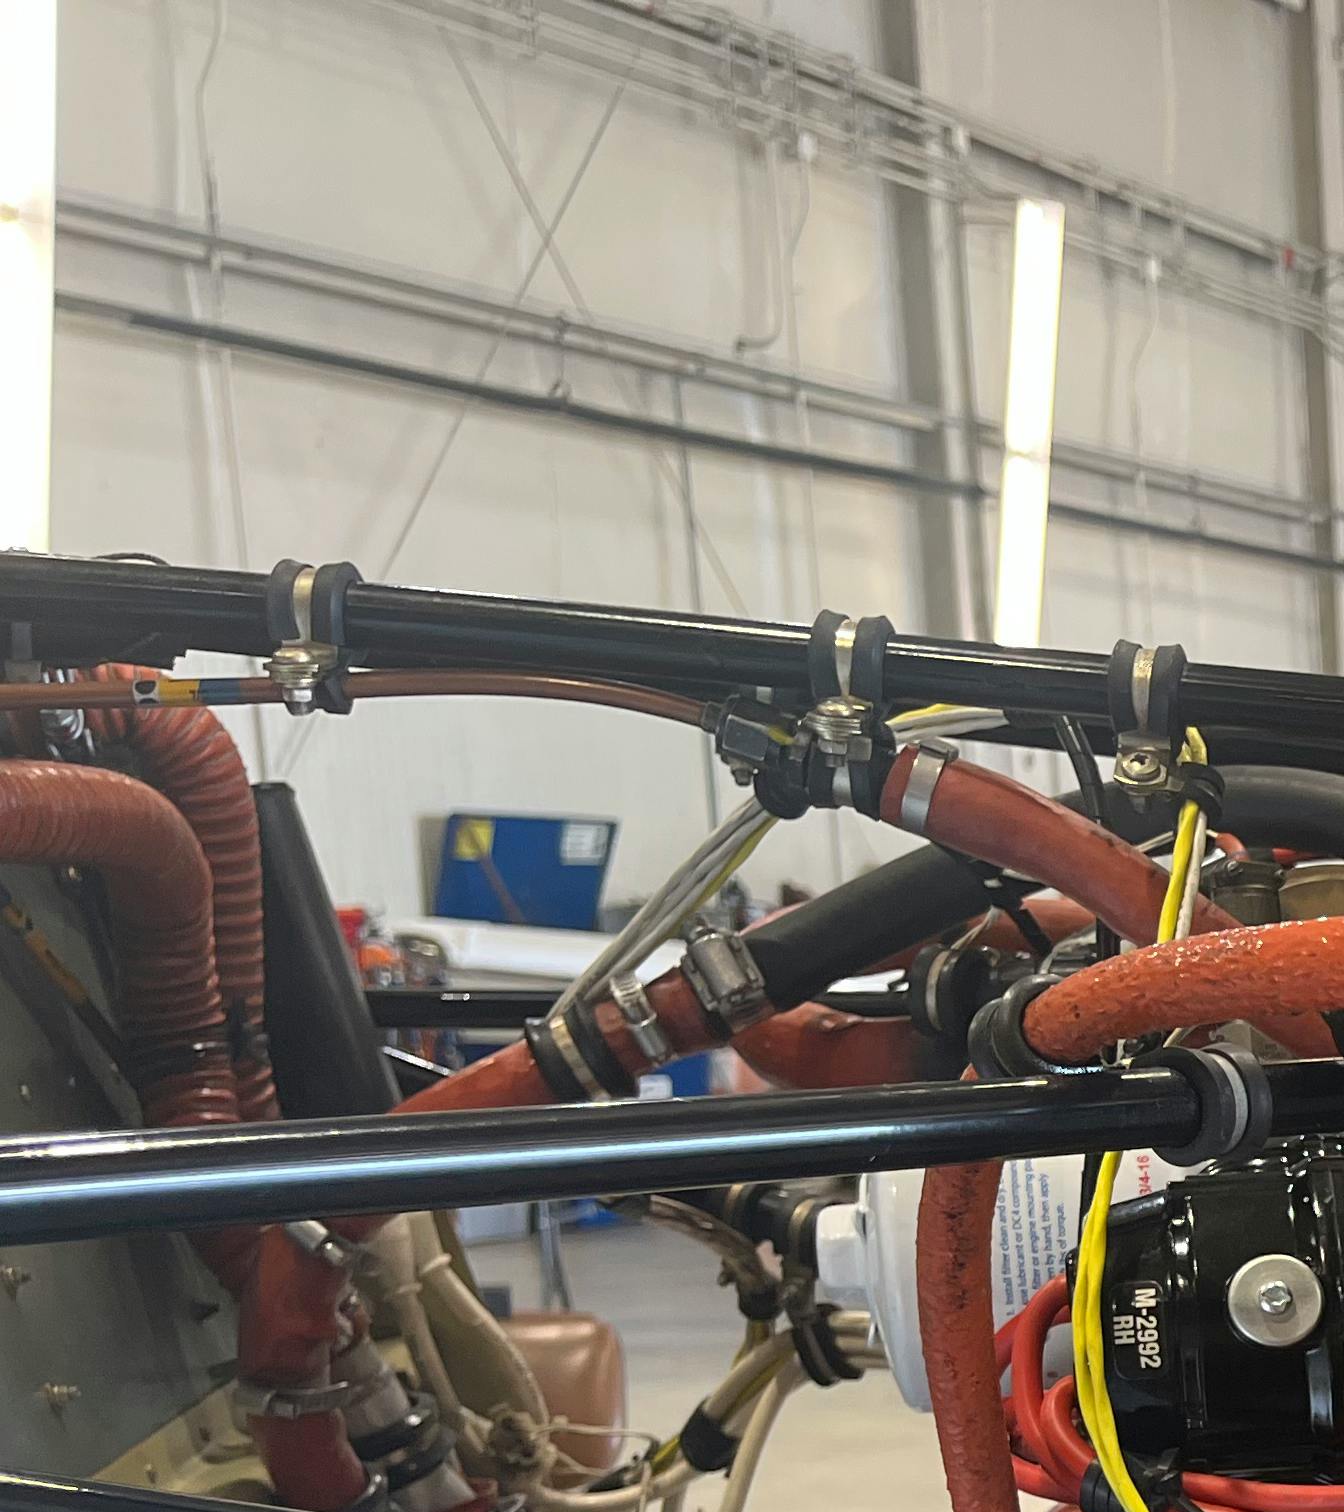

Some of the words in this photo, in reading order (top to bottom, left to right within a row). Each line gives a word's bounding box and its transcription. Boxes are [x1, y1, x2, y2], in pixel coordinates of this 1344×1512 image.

[1024, 1173, 1037, 1220] mounting
[1038, 1172, 1051, 1198] apply
[996, 1205, 1007, 1223] and
[1039, 1200, 1050, 1222] then
[1055, 1202, 1067, 1238] torque.
[998, 1225, 1009, 1252] clean
[1015, 1232, 1023, 1243] or
[1028, 1221, 1040, 1254] engine
[1055, 1238, 1066, 1250] of
[1001, 1252, 1012, 1276] filter
[1015, 1244, 1028, 1289] lubricant
[1031, 1255, 1040, 1265] or
[1044, 1253, 1056, 1265] by
[1001, 1277, 1014, 1306] Install
[1112, 1314, 1135, 1345] RH
[1135, 1287, 1162, 1369] M-2992
